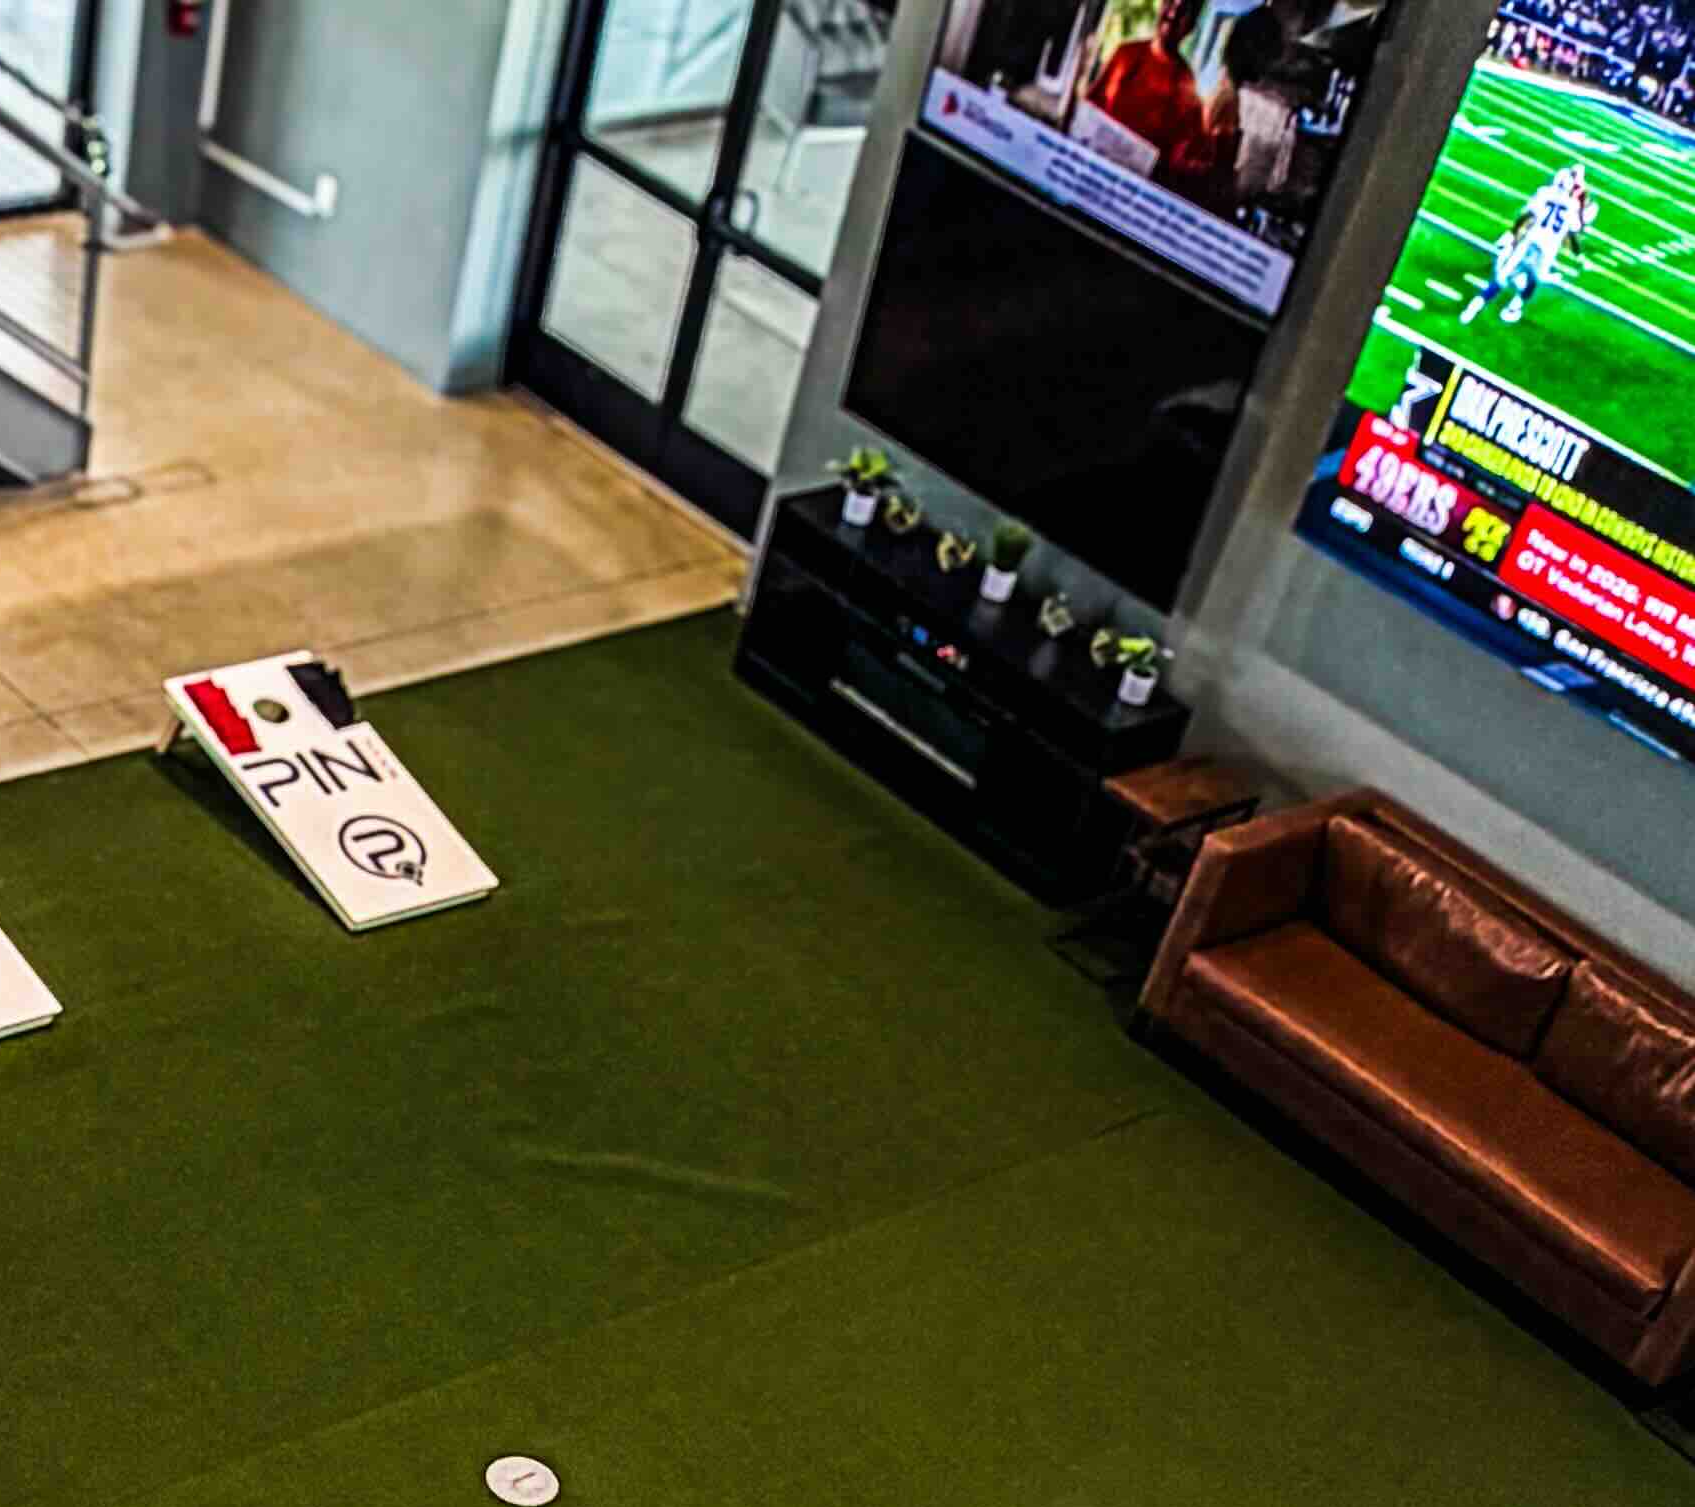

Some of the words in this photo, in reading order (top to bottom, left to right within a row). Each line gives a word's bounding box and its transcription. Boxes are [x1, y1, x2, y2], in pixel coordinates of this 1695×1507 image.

[1541, 200, 1568, 233] 75
[1484, 393, 1590, 481] PRESCOTT
[1354, 445, 1458, 535] 49ERS
[1527, 529, 1568, 562] New
[1516, 550, 1546, 575] OT
[1623, 611, 1678, 659] Lowe,
[240, 739, 384, 807] PIN
